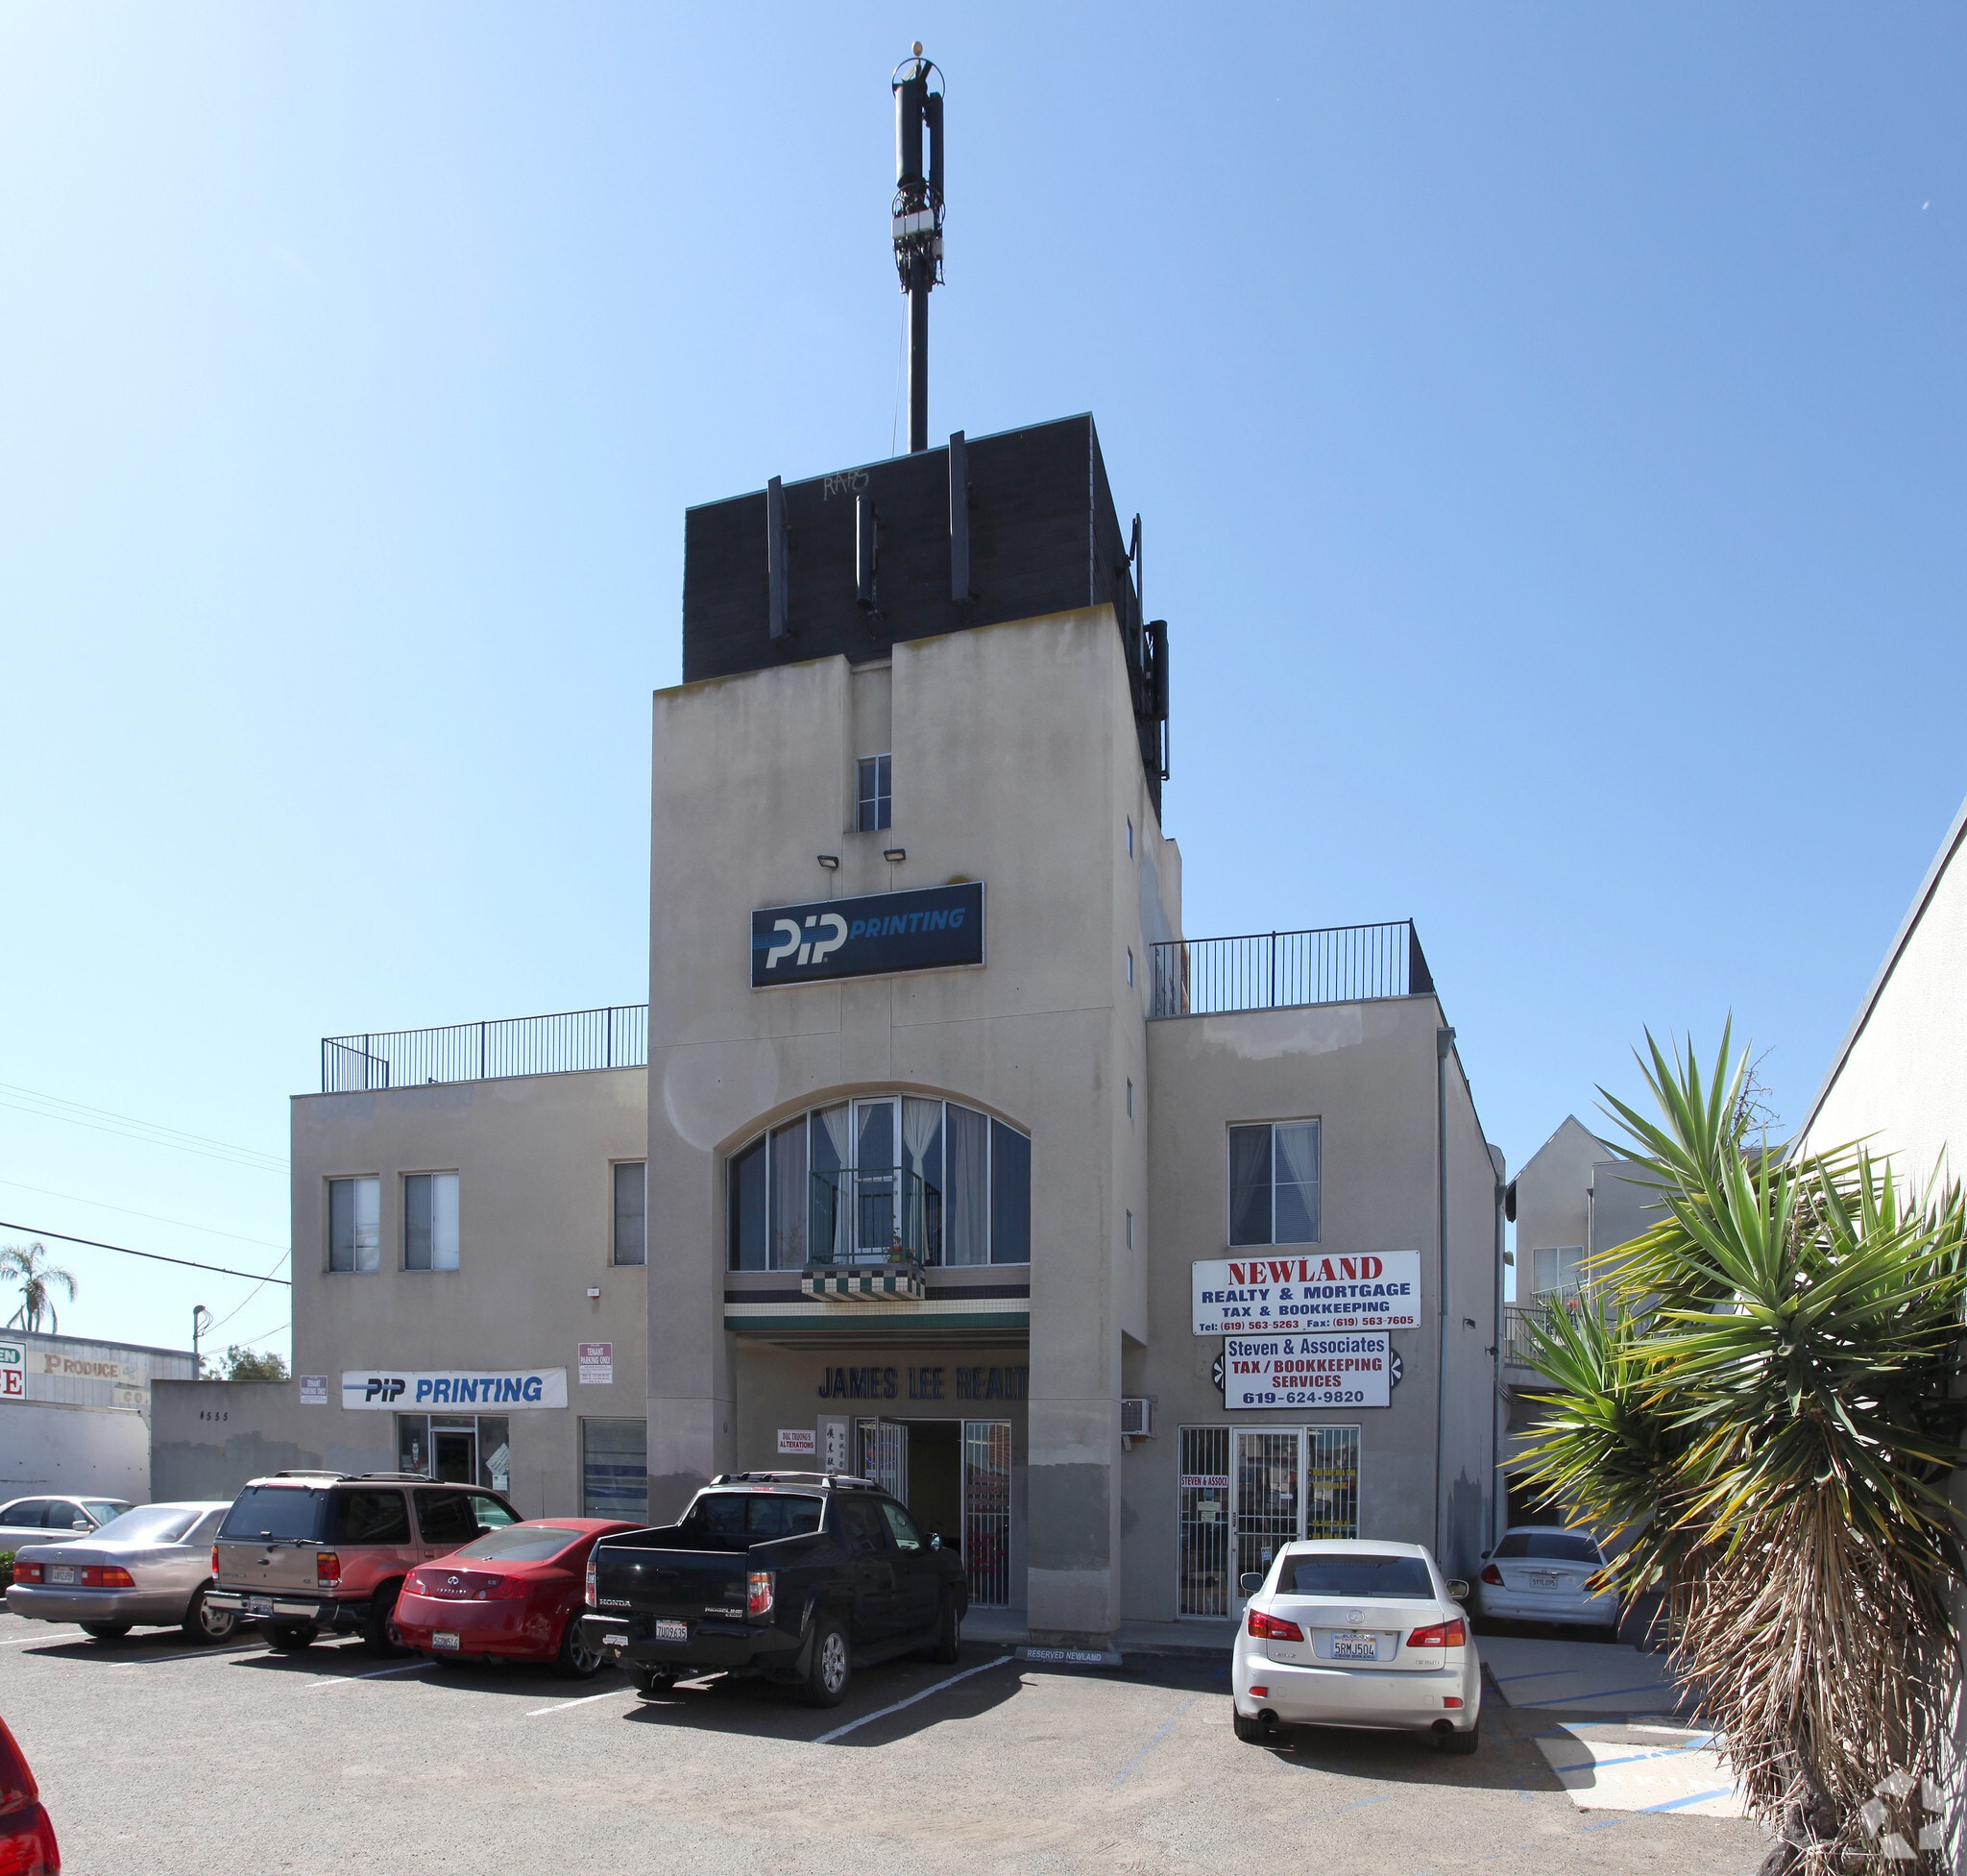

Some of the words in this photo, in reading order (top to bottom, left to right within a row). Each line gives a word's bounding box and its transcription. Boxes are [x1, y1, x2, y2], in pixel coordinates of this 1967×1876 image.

[765, 913, 848, 969] PIP
[850, 908, 965, 939] PRINTING
[1228, 1256, 1383, 1285] NEWLAND
[1202, 1288, 1270, 1303] REALTY
[1279, 1287, 1294, 1301] &
[1303, 1282, 1411, 1300] MORTGAGE
[1222, 1306, 1251, 1318] TAX
[1259, 1305, 1271, 1317] &
[1278, 1301, 1390, 1316] BOOKKEEPING
[1199, 1323, 1218, 1331] Tel:
[1221, 1321, 1245, 1331] (619)
[1249, 1320, 1299, 1329] 563-5263
[1307, 1319, 1329, 1328] Fax:
[1333, 1317, 1358, 1328] (619)
[1362, 1315, 1414, 1326] 563-7605
[587, 1347, 604, 1355] TENANT
[1228, 1340, 1278, 1356] Steven
[1283, 1338, 1295, 1354] &
[1300, 1336, 1385, 1354] Associates
[44, 1353, 118, 1377] PRODUCE
[580, 1355, 599, 1364] PARKING
[599, 1355, 611, 1364] ONLY
[0, 1369, 22, 1395] E
[365, 1378, 405, 1401] PIP
[416, 1377, 543, 1402] PRINTING
[817, 1367, 898, 1400] JAMES
[909, 1367, 945, 1400] LEE
[956, 1367, 1029, 1400] REALT
[1272, 1375, 1342, 1388] SERVICES
[1243, 1390, 1365, 1404] 619-624-9820
[200, 1410, 229, 1422] 4555
[1181, 1476, 1202, 1486] STEVEN
[1202, 1476, 1207, 1486] &
[599, 1598, 632, 1607] HONDA
[1027, 1649, 1064, 1660] RESERVED
[1066, 1651, 1102, 1662] NEWLAND
[1335, 1642, 1374, 1655] 5RMJ504
